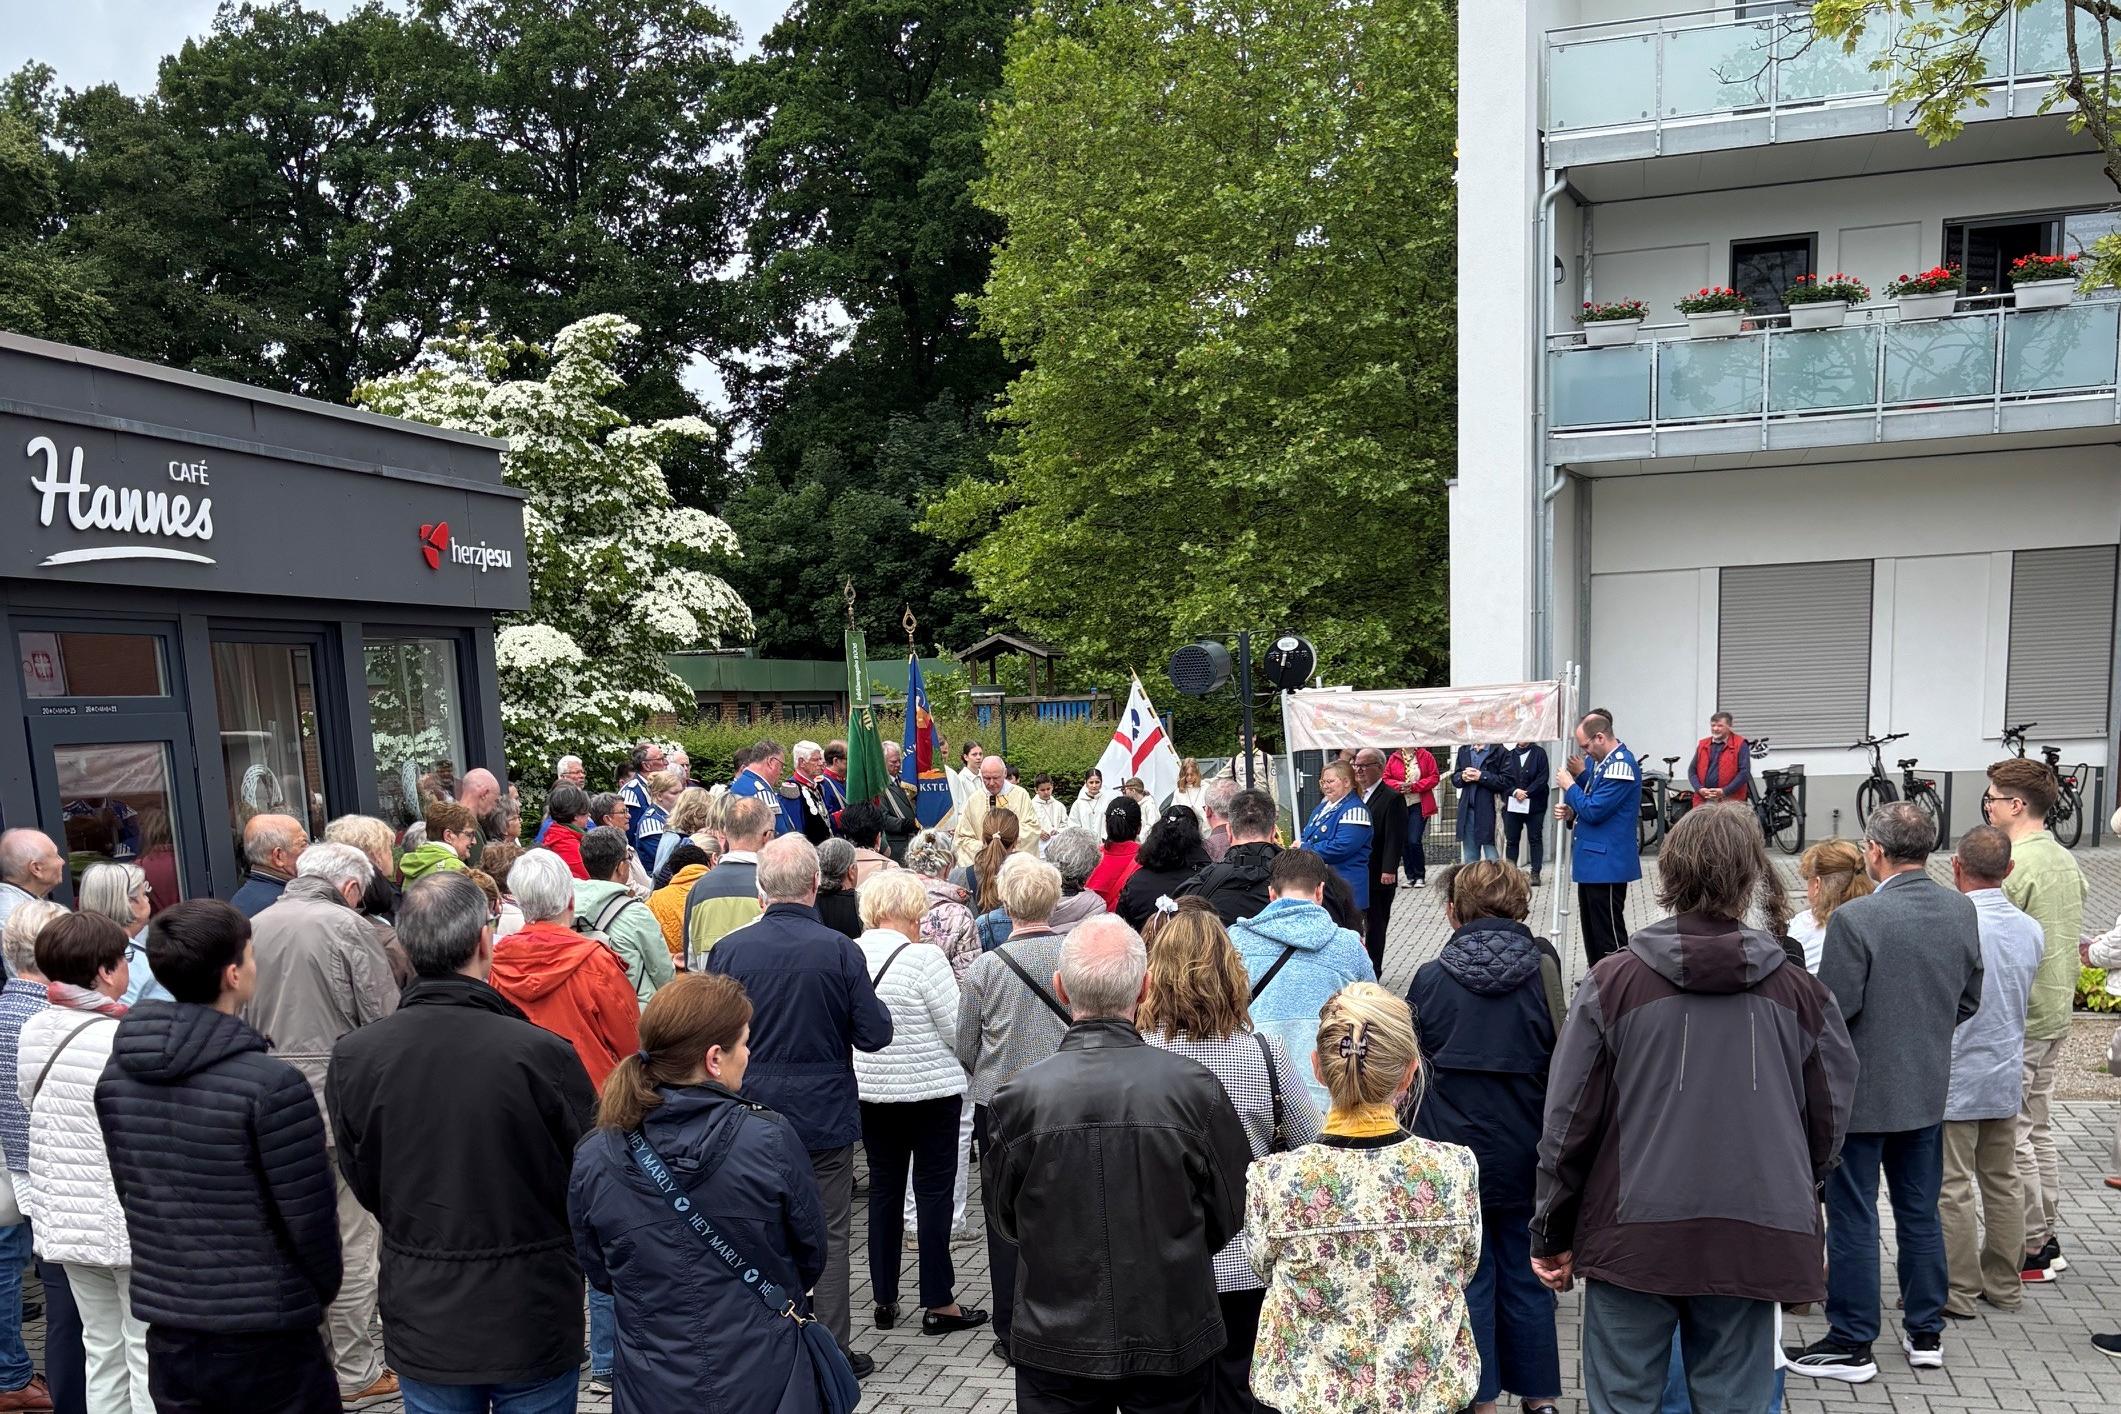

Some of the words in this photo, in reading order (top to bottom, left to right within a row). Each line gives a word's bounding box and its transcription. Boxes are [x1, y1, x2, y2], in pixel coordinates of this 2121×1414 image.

[26, 436, 214, 541] Hannes
[169, 459, 209, 485] CAFÉ
[450, 536, 512, 572] herzjesu
[628, 1129, 648, 1153] HEY
[641, 1153, 678, 1194] MARLY
[688, 1212, 714, 1236] HEY
[708, 1235, 747, 1269] MARLY
